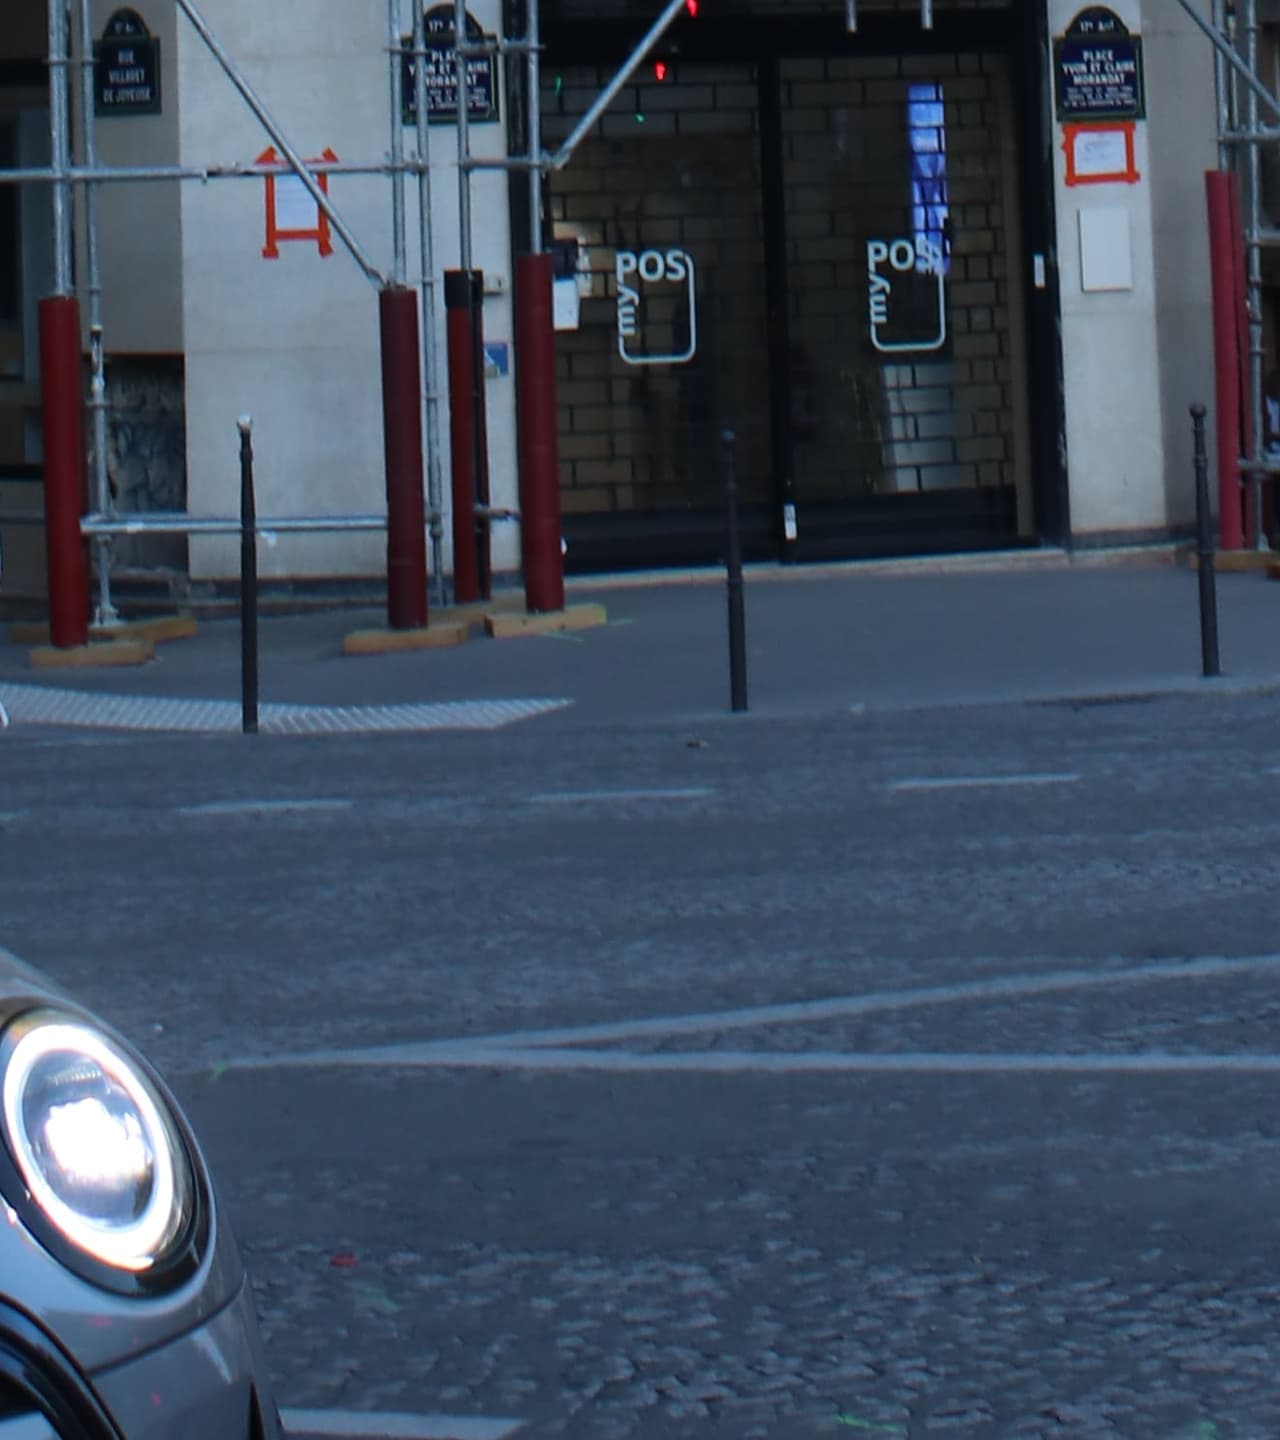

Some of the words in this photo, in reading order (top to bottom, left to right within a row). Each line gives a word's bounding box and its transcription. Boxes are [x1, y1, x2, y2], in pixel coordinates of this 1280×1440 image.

[616, 249, 687, 282] POS
[618, 281, 640, 337] my
[869, 272, 891, 325] my
